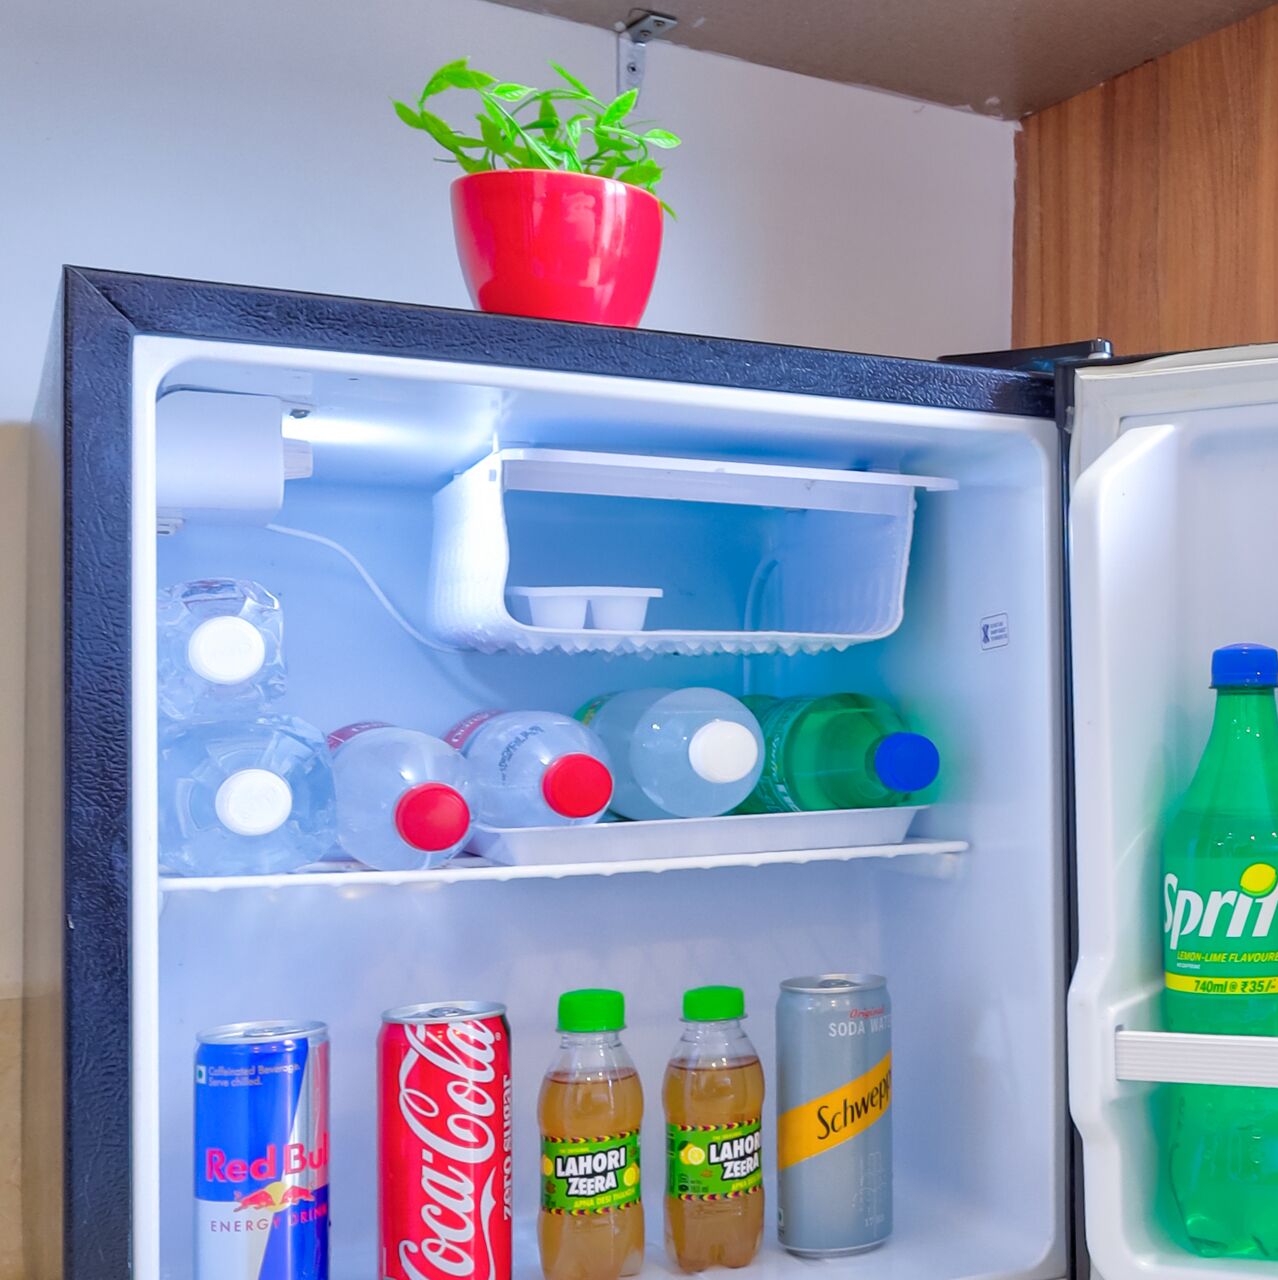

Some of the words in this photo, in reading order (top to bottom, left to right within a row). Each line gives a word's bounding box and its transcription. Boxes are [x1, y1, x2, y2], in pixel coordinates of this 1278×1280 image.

[1177, 950, 1227, 963] LEMON-LIME
[1194, 979, 1228, 993] 740ml
[828, 1021, 866, 1037] SODA
[870, 1015, 891, 1033] WAT
[503, 1074, 512, 1153] sugar
[206, 1144, 277, 1182] Red
[556, 1146, 626, 1178] LAHORI
[722, 1151, 760, 1180] ZEERA
[503, 1156, 512, 1221] zero
[567, 1170, 617, 1196] ZEERA
[210, 1216, 281, 1233] ENERGY
